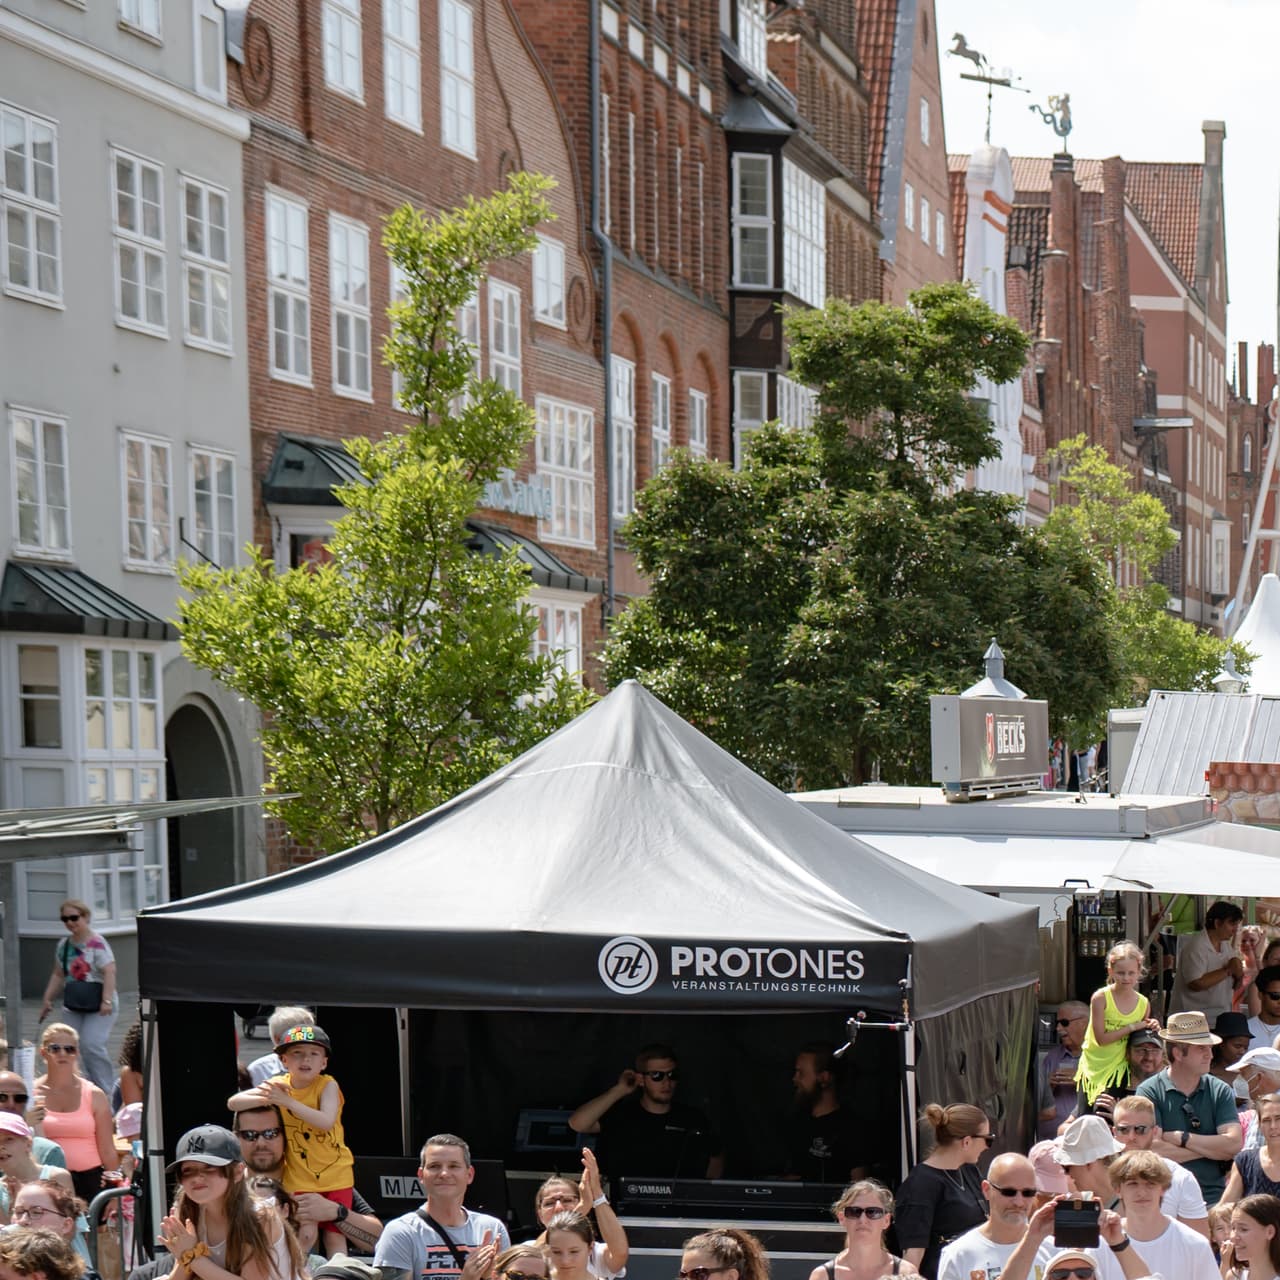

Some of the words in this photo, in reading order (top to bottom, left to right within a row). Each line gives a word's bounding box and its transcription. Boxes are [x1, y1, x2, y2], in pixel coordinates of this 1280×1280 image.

[670, 946, 866, 981] PROTONES
[671, 980, 862, 994] VERANSTALTUNGSTECHNIK
[638, 1185, 672, 1194] YAMAHA
